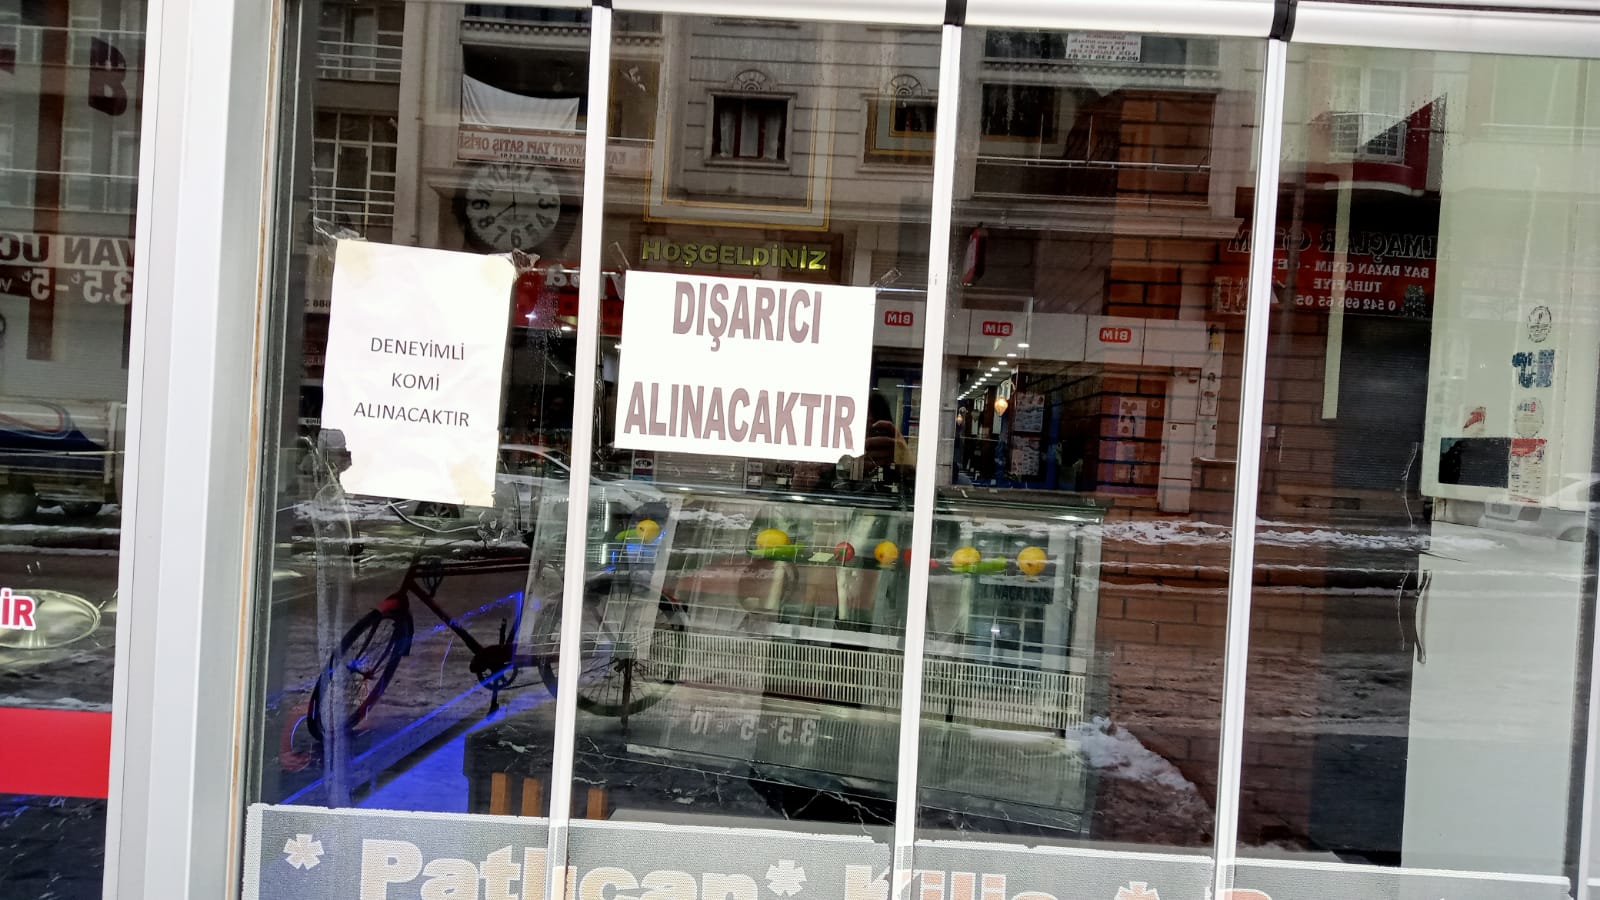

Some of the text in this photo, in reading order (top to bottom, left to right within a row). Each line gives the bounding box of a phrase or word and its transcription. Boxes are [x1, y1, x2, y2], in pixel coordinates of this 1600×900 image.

[642, 239, 827, 271] HOŞGELDİNİZ
[672, 280, 823, 352] DIŞARICI
[370, 336, 465, 361] DENEYİMLİ
[391, 372, 440, 391] KOMİ
[353, 402, 470, 427] ALINACAKTIR
[623, 381, 856, 450] ALINACAKTIR
